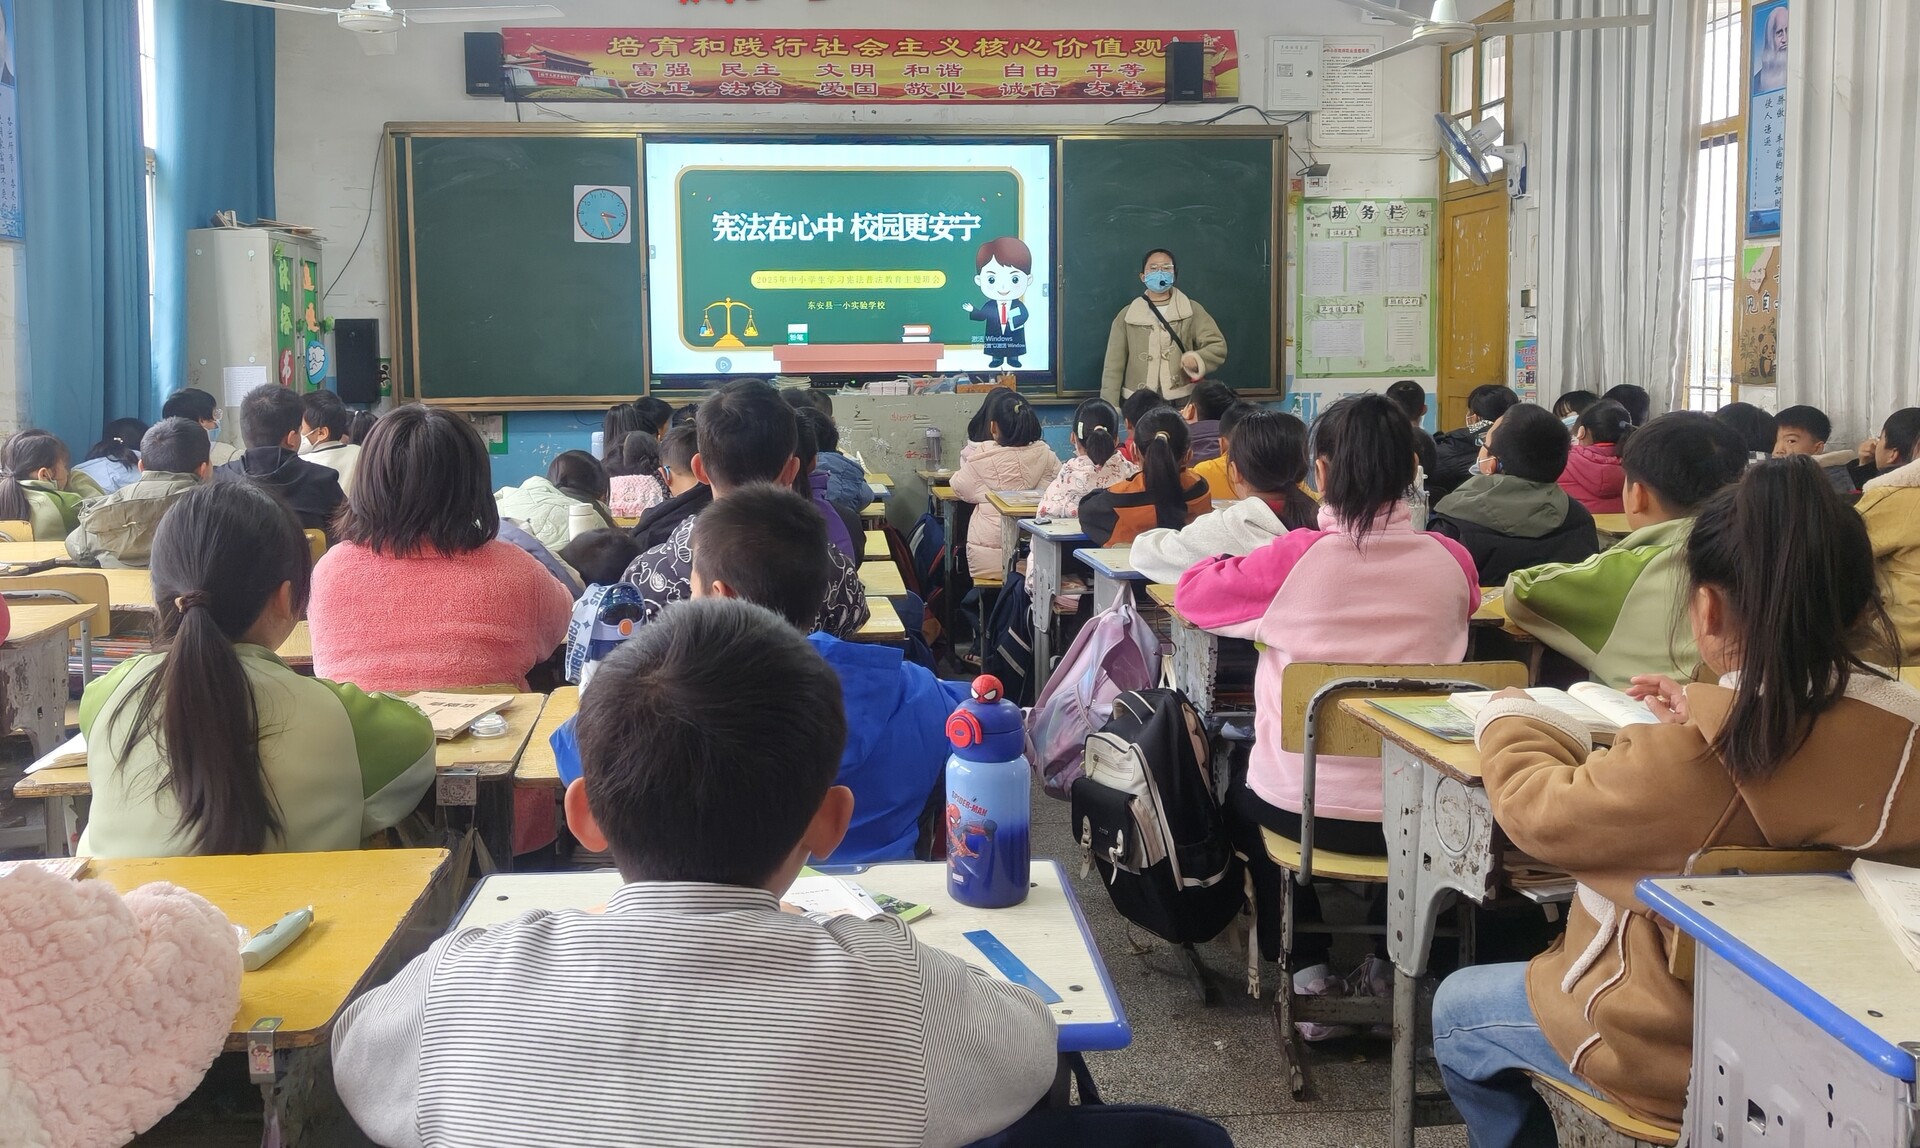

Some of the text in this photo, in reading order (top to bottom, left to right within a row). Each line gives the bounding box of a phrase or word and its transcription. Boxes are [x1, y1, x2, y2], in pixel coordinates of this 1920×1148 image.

[607, 37, 1165, 58] 培育和践行社会主义核心价值观
[632, 62, 1146, 78] 富强 民主 文明 和谐 自由 平等
[629, 81, 1146, 97] 公正 法治 爱国 敬业 诚信 友善
[712, 211, 981, 242] 宪法在心中 校园更安宁
[807, 300, 886, 311] 东安县一小实验学校
[952, 790, 988, 817] SPIDER-MAN
